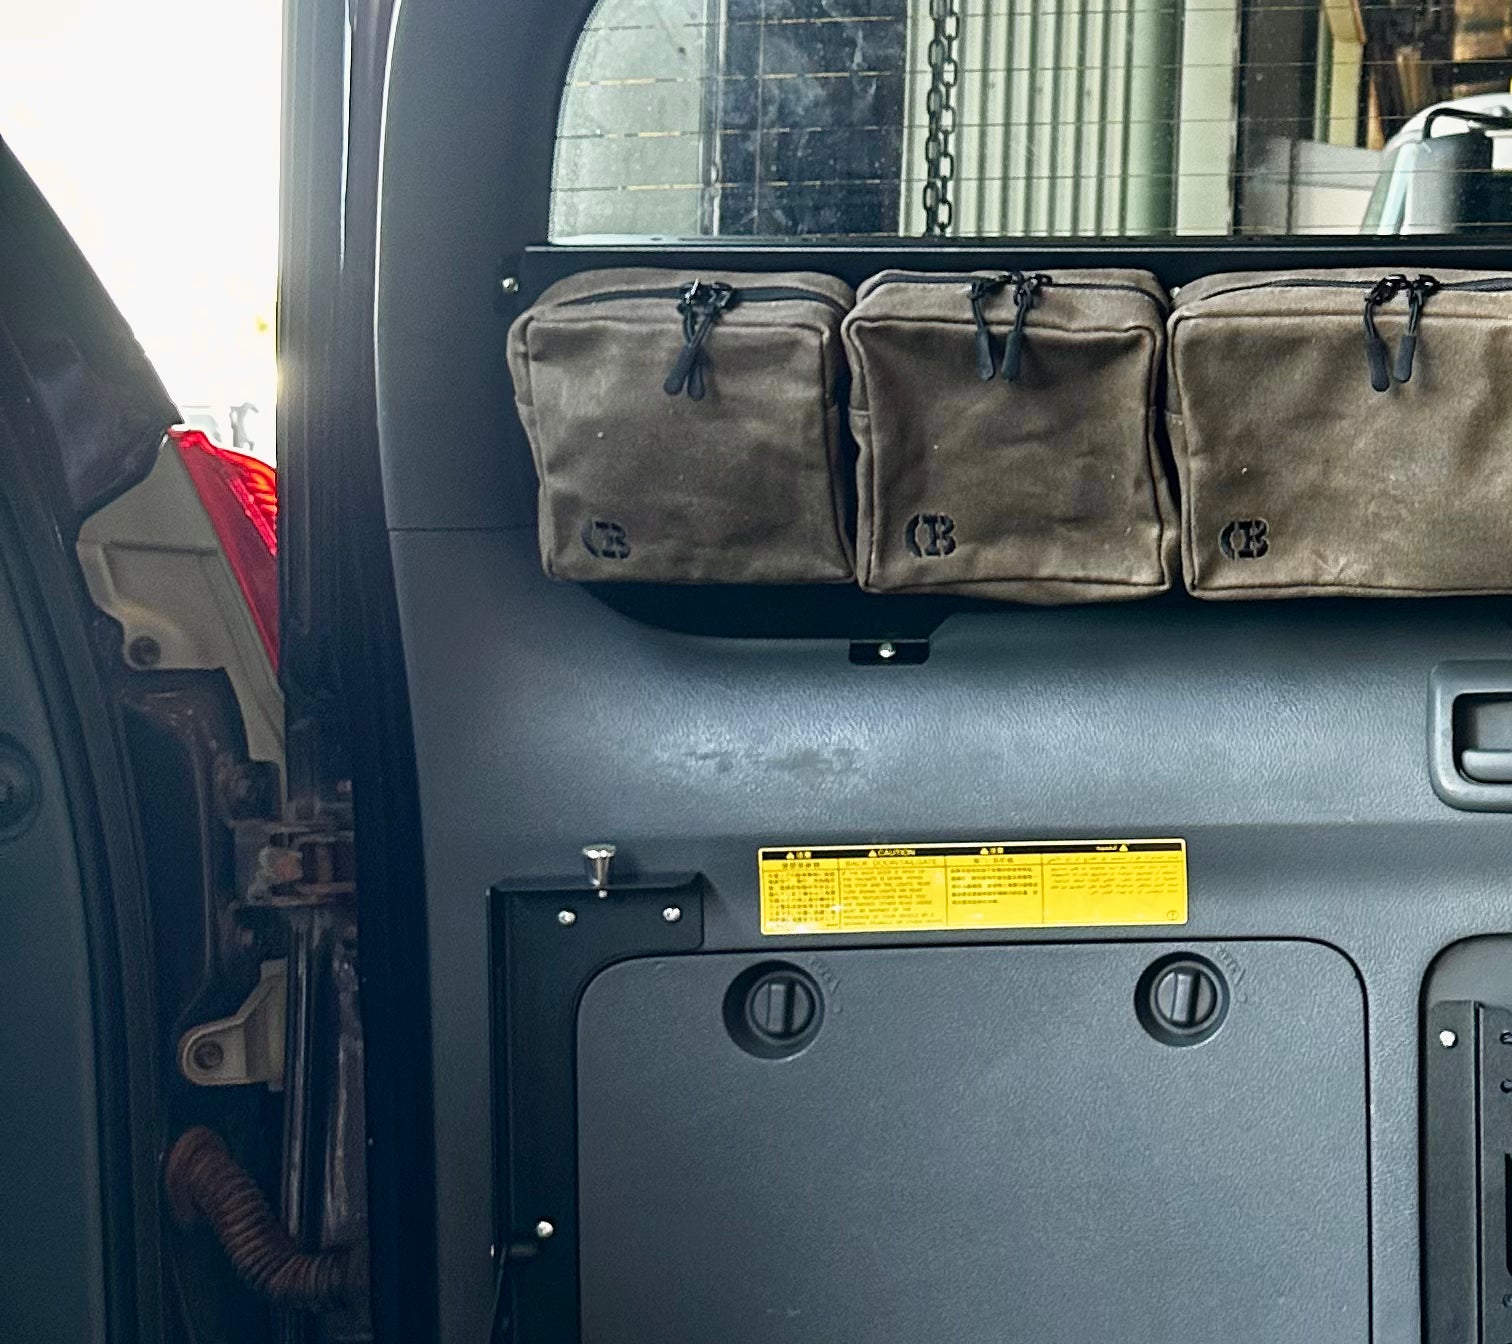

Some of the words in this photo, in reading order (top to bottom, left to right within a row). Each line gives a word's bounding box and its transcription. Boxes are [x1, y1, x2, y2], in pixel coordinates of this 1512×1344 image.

[905, 514, 956, 557] CB
[1220, 520, 1269, 559] CB
[877, 848, 916, 857] CAUTION
